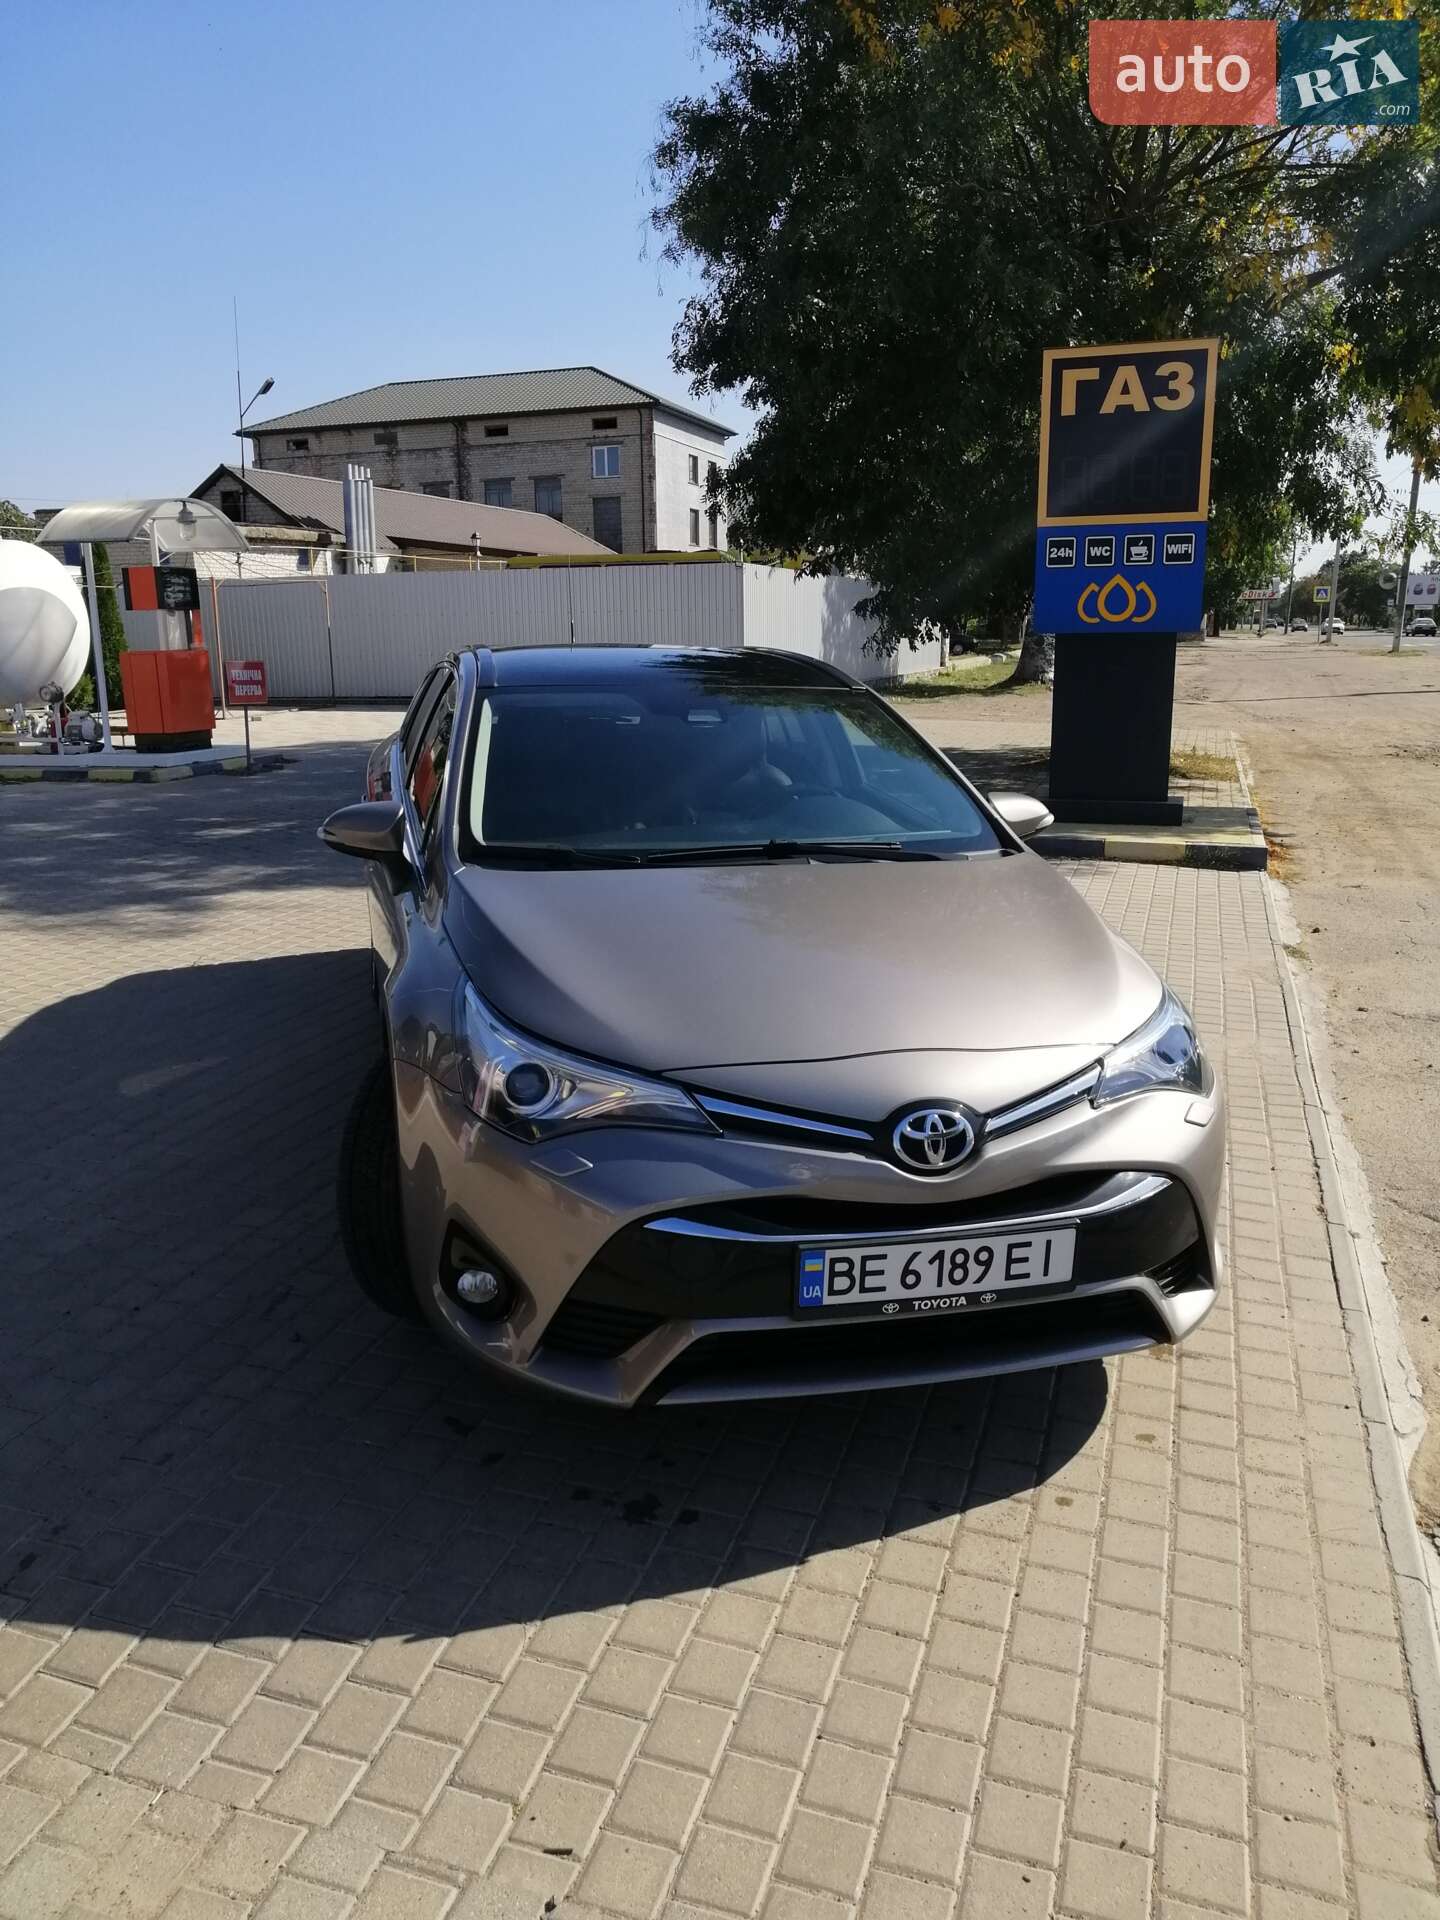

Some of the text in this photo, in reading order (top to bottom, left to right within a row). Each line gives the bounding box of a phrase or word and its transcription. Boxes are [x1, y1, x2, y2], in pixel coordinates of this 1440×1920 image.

[1061, 361, 1195, 416] ГАЗ
[1049, 547, 1073, 558] 24h
[1089, 546, 1111, 557] WC
[235, 685, 262, 696] ПЕРЕРВА
[827, 1239, 1052, 1296] BE 6189 EI
[803, 1285, 821, 1298] UA
[912, 1296, 967, 1311] TOYOTA
